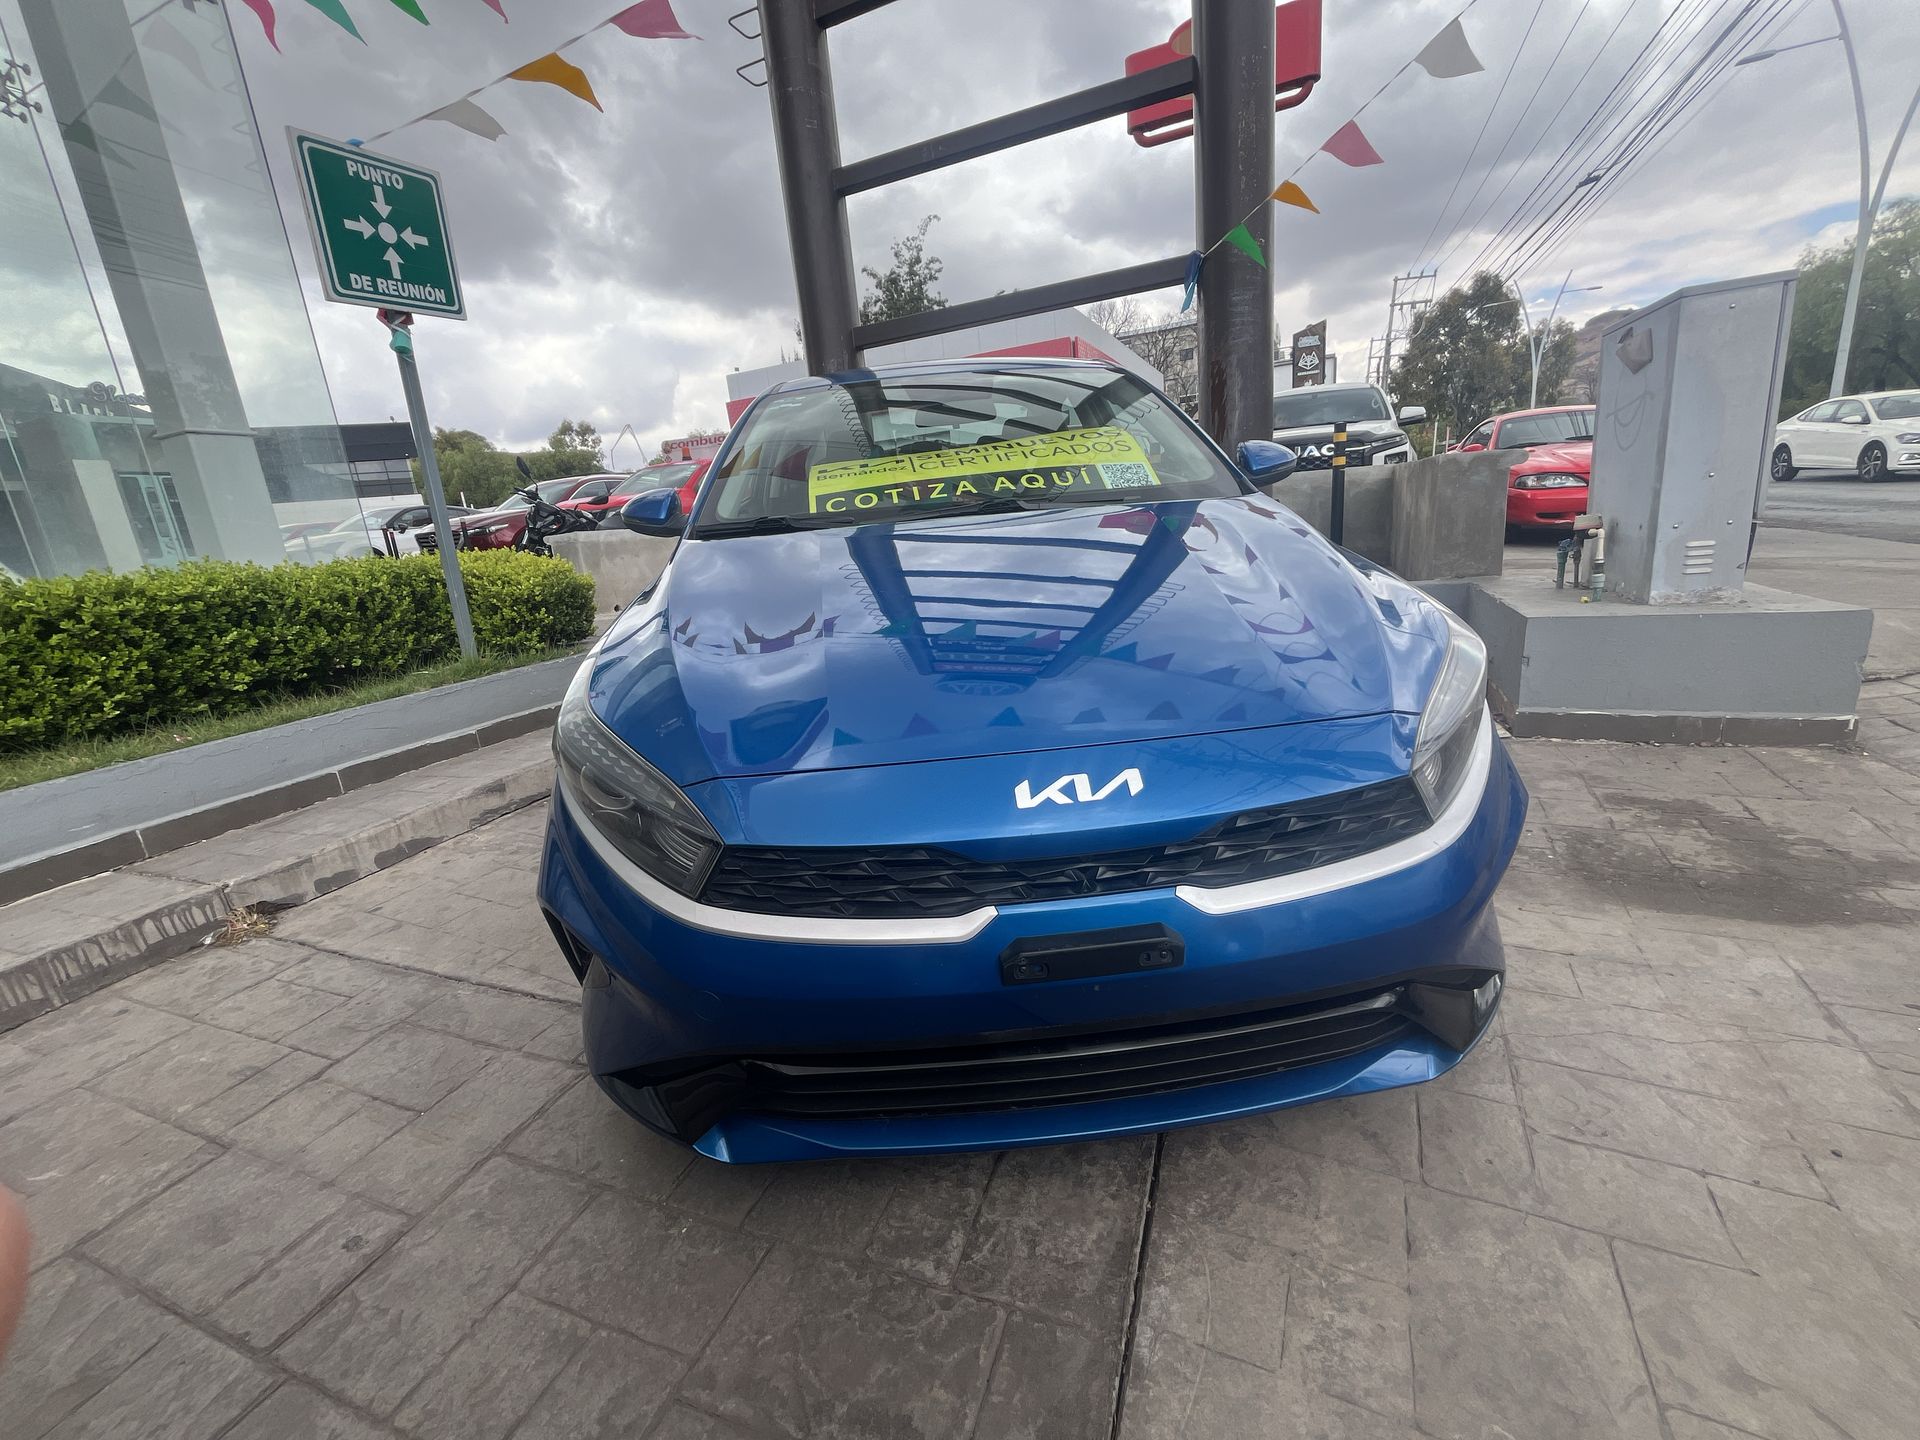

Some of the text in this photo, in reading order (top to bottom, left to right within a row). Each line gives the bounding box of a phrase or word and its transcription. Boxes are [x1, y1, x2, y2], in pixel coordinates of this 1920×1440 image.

[345, 160, 404, 190] PUNTO
[350, 273, 446, 304] DE REUNIÓN
[916, 429, 1123, 460] SEMINUEVOS
[919, 440, 1133, 470] CERTIFICADOS
[825, 467, 1092, 513] COTIZA AQUÍ
[1014, 767, 1144, 809] KIA
